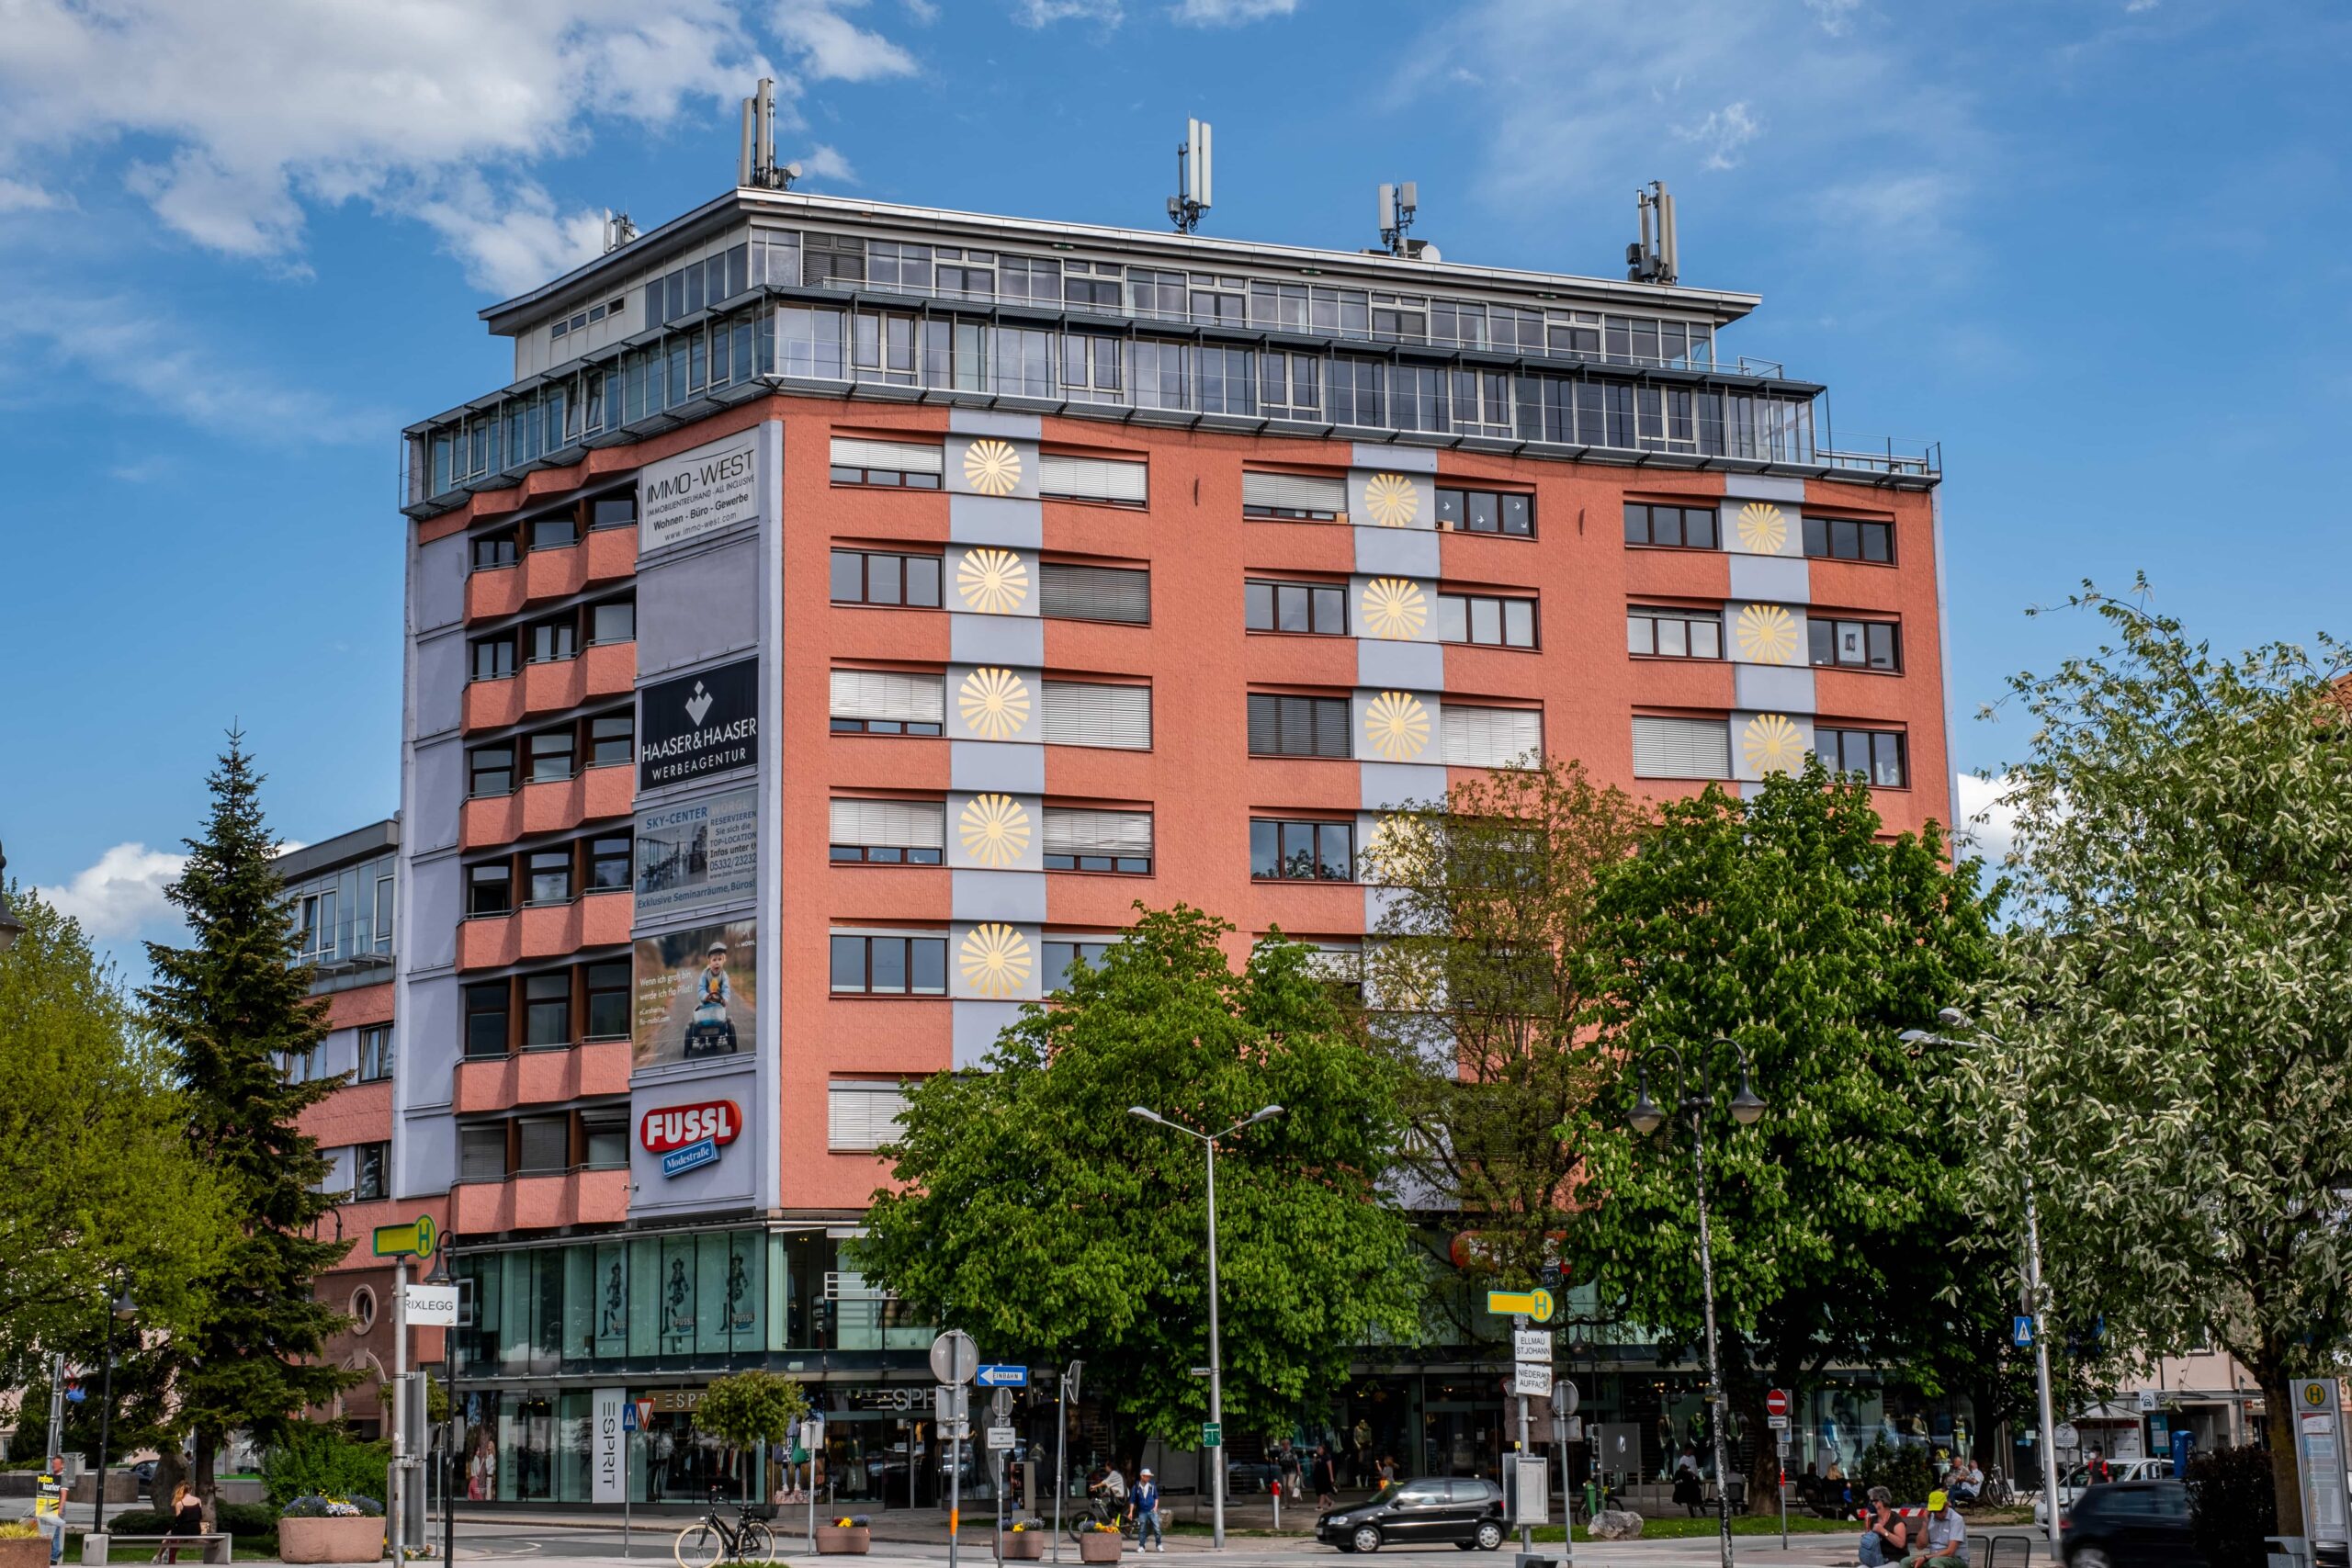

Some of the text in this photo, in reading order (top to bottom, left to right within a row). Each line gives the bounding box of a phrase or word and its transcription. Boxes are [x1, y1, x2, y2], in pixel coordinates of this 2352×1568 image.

[647, 489, 712, 517] IMMOBILIENTREUHAND
[716, 483, 725, 494] ALL
[726, 473, 755, 491] INCLUSIVE
[653, 513, 684, 532] Wohnen
[690, 506, 708, 520] Büro
[715, 492, 749, 511] Gewerbe
[664, 512, 737, 542] www.immo-west.com
[642, 717, 757, 763] HAASER&HAASER
[651, 747, 746, 781] WERBEAGENTUR
[646, 807, 708, 829] SKY-CENTER
[710, 809, 757, 827] RESERVIEREN
[716, 822, 752, 836] Sie sich die
[710, 831, 757, 847] TOP-LOCATION
[709, 852, 757, 872] 05332/23232
[710, 844, 750, 859] Infos unter
[638, 878, 756, 909] Exklusive Seminarräume, Büros!
[639, 976, 657, 987] Wenn
[657, 974, 666, 984] ich
[639, 990, 657, 1001] werde
[658, 988, 667, 998] ich
[647, 1106, 731, 1145] FUSSL
[666, 1146, 710, 1170] Modestraße
[418, 1223, 430, 1251] H
[1534, 1295, 1547, 1316] H
[1521, 1337, 1545, 1346] ELLMAU
[2310, 1387, 2319, 1402] H
[603, 1401, 616, 1489] ESPRIT
